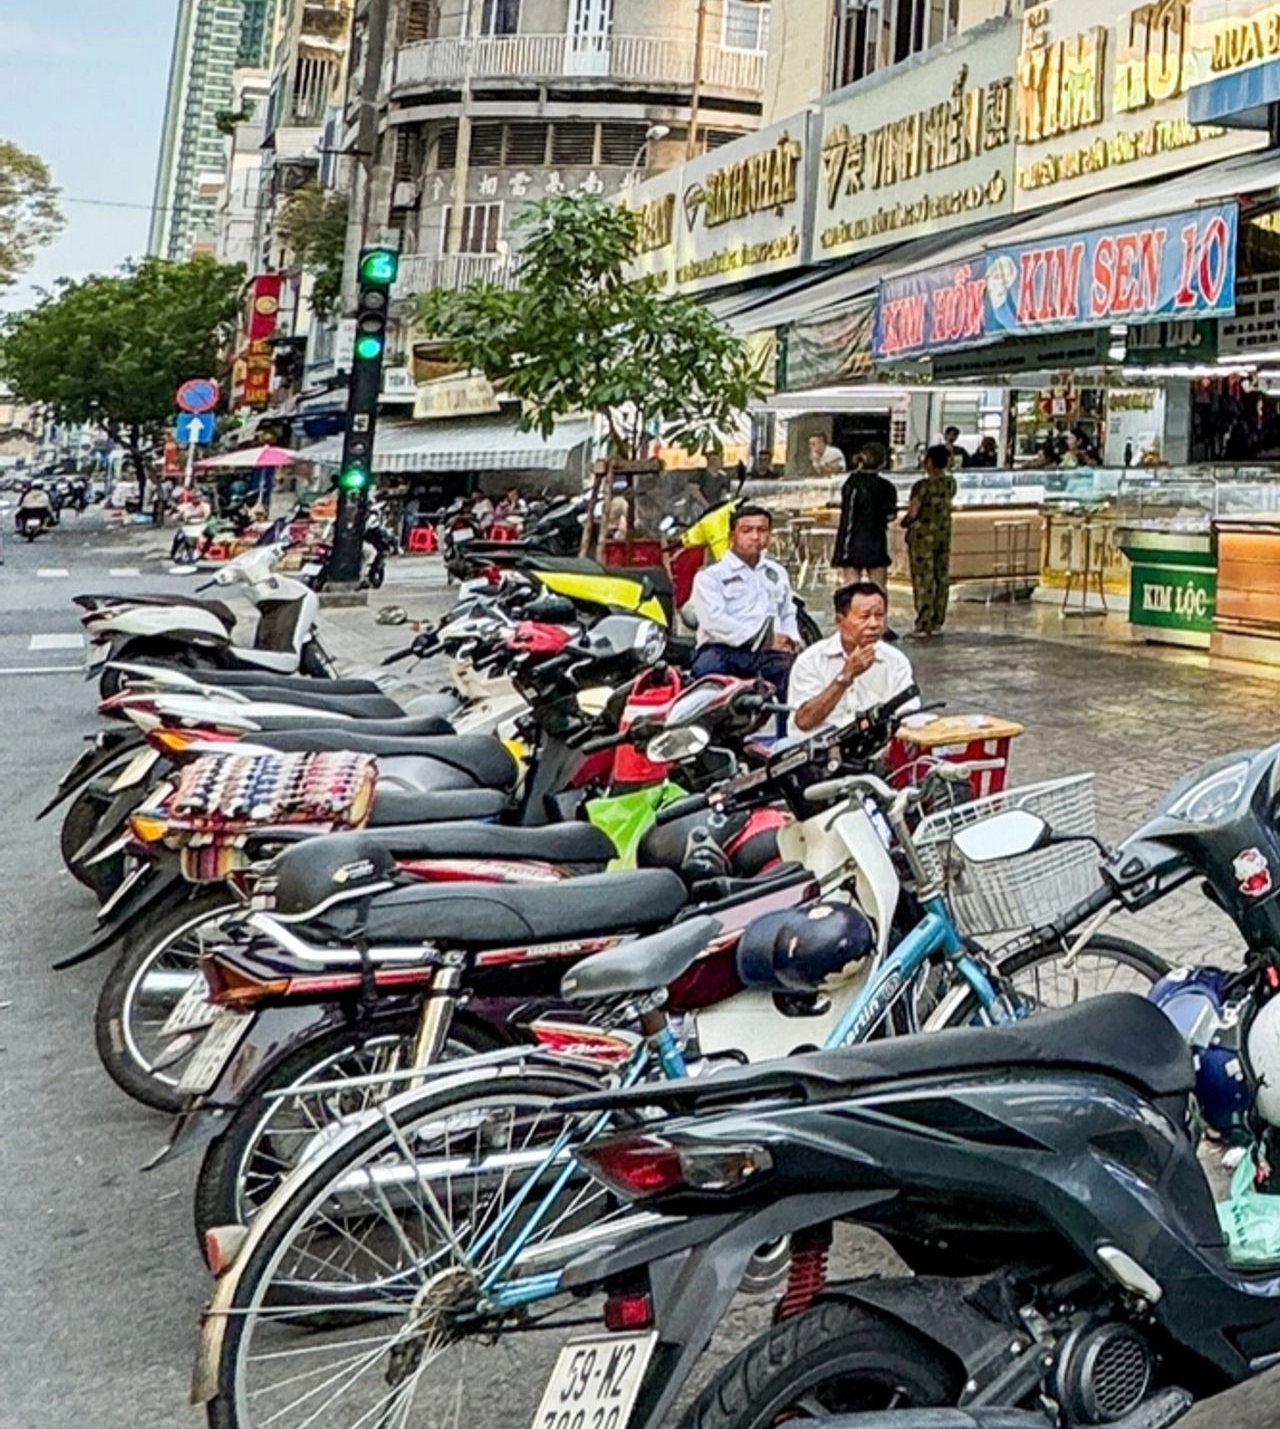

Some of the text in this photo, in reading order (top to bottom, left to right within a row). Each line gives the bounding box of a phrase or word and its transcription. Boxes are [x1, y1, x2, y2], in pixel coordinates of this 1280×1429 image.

[1211, 18, 1266, 72] MUA
[1015, 215, 1229, 325] KIM SEN 10
[880, 293, 927, 353] KIM
[1142, 579, 1208, 621] KIM LỘC
